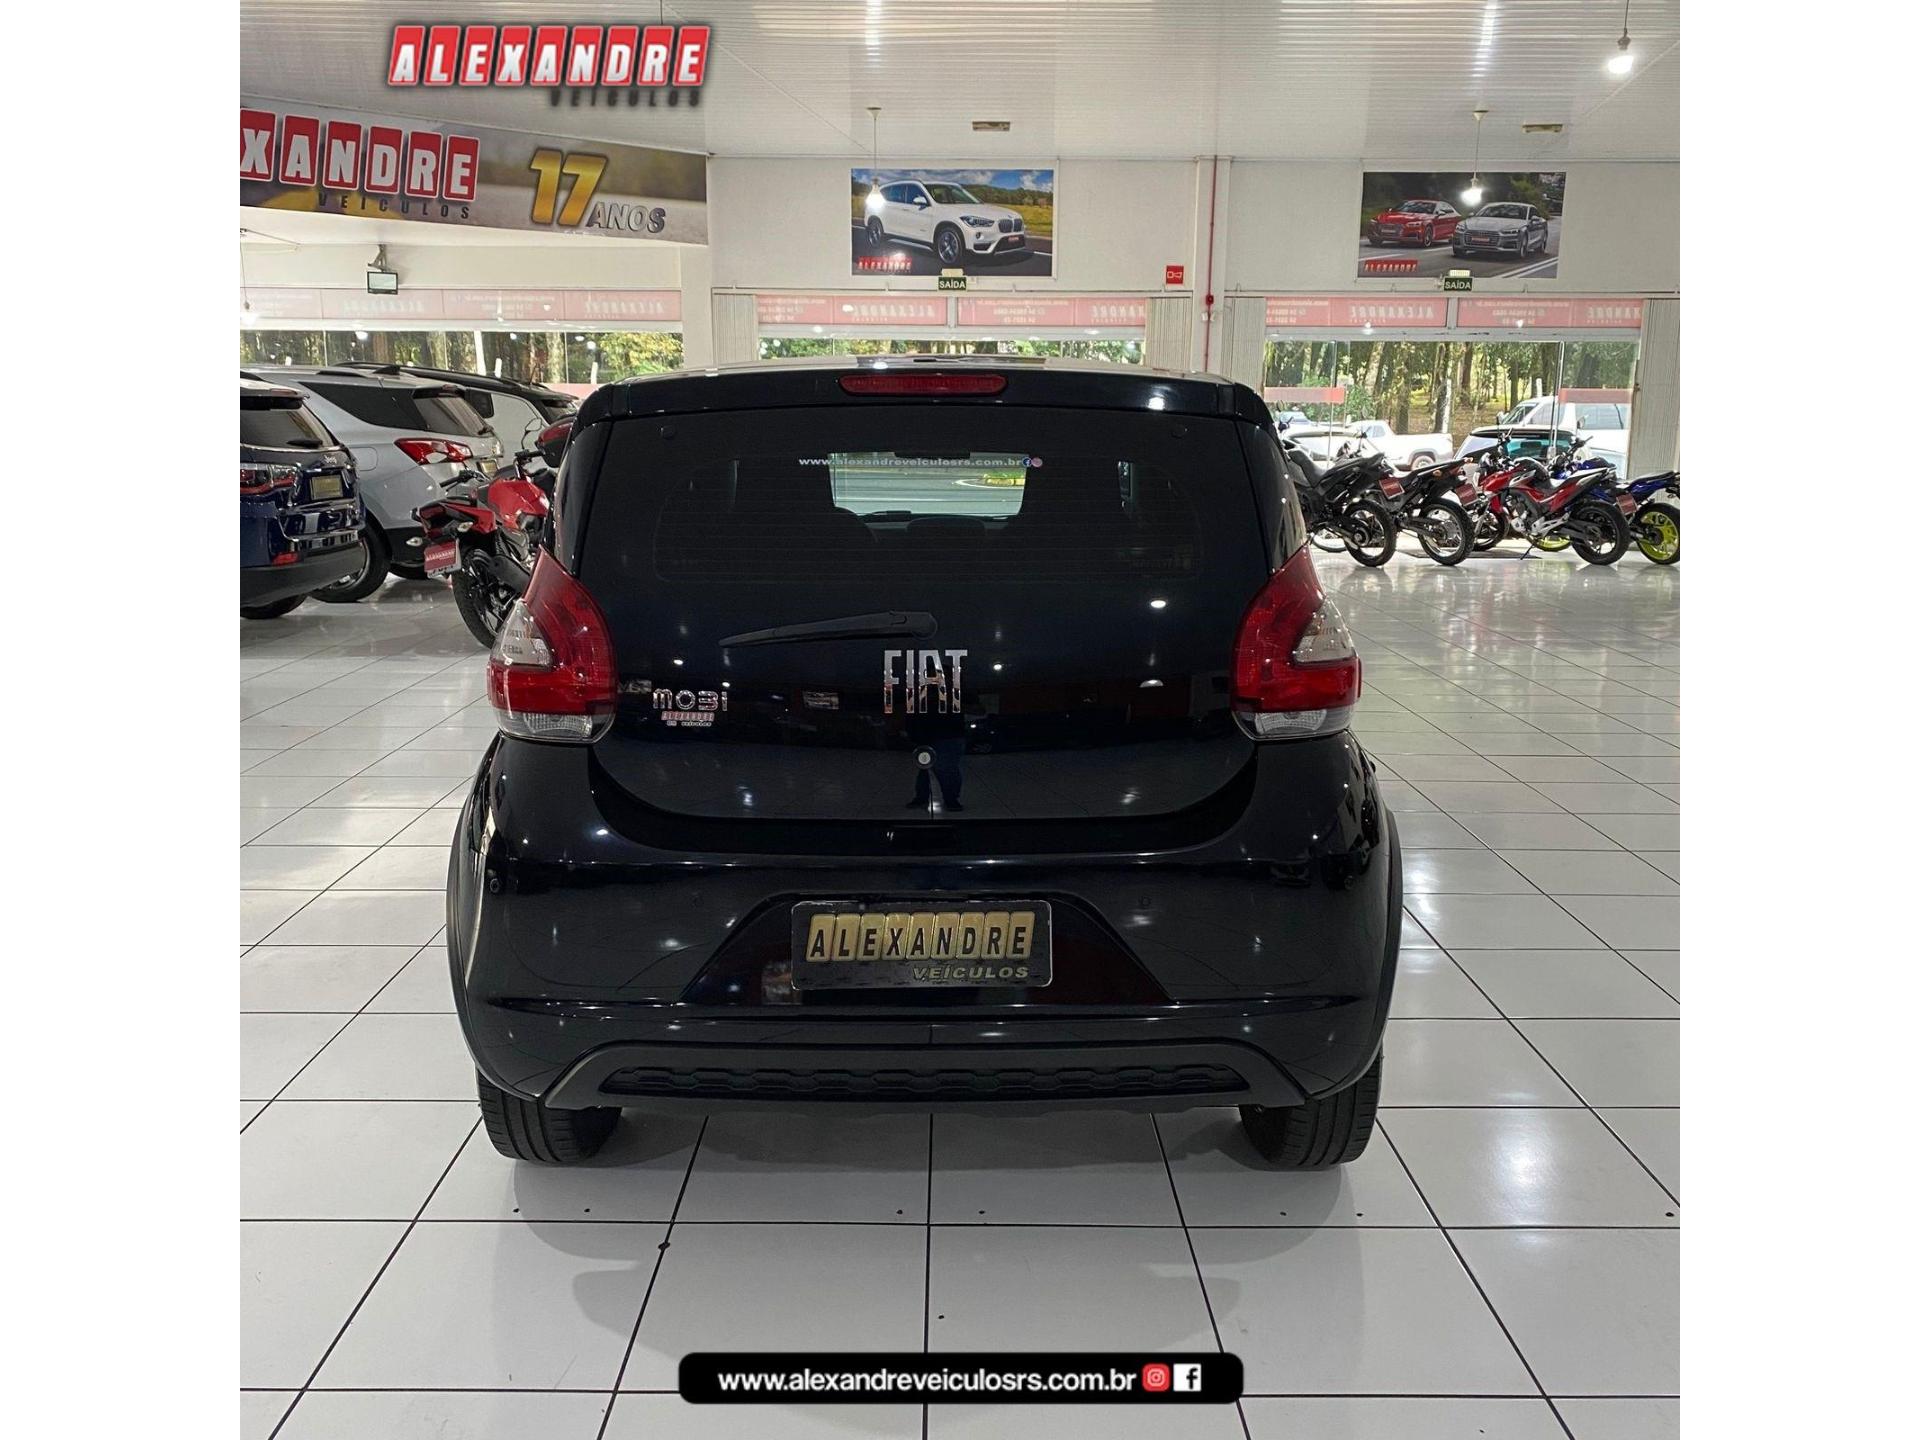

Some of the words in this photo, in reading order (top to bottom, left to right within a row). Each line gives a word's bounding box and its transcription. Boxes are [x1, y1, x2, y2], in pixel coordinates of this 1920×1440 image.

[240, 124, 473, 197] XANDRE
[530, 148, 608, 226] 17
[586, 201, 666, 233] ANOS
[939, 278, 966, 290] SAÍDA
[1445, 281, 1471, 290] SAÍDA
[884, 650, 967, 713] FIAT
[808, 922, 1030, 959] ALEXANDRE
